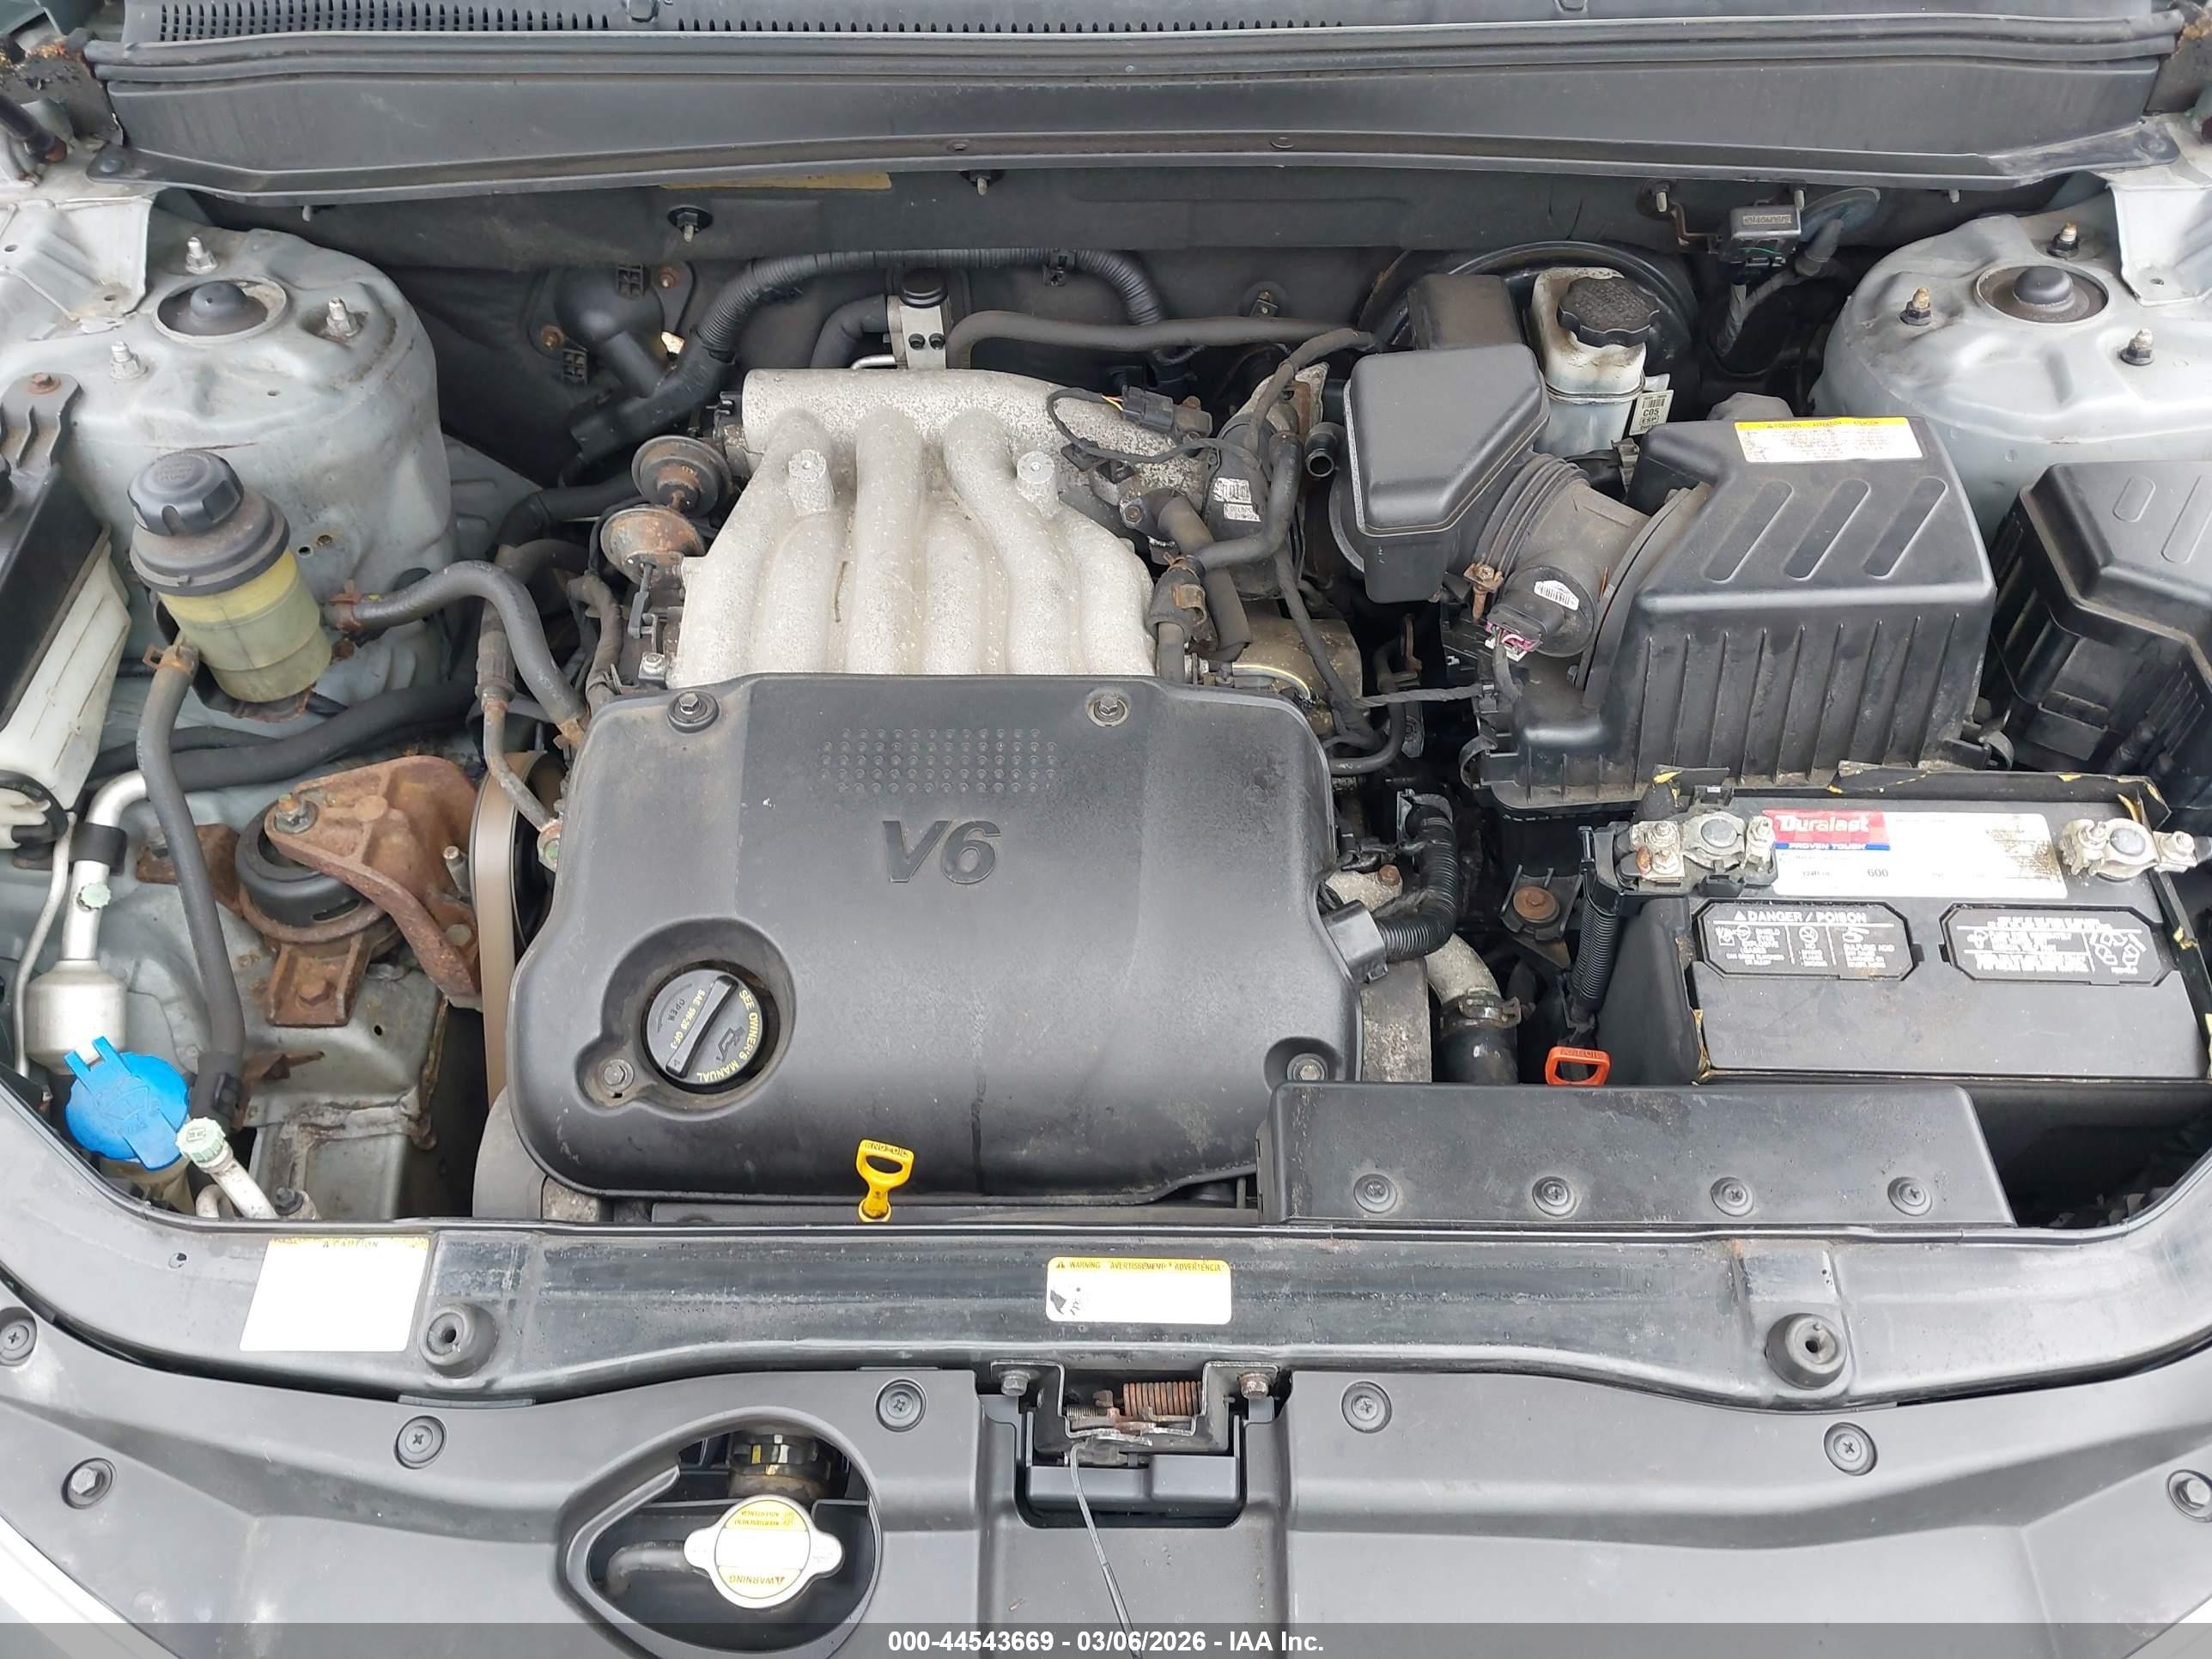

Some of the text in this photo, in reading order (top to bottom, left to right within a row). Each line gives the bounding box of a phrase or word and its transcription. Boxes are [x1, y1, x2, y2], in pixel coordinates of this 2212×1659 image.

[1775, 812, 1870, 832] Duralast
[882, 821, 1002, 884] V6
[1867, 868, 1889, 878] 600
[1747, 911, 1803, 921] DANGER
[1816, 912, 1868, 923] POISON
[692, 988, 707, 1006] SAE
[667, 999, 685, 1022] OPEN
[696, 989, 760, 1083] SEE OWNER'S MANUAL
[865, 1141, 886, 1152] ENG
[729, 1574, 775, 1585] WARNING
